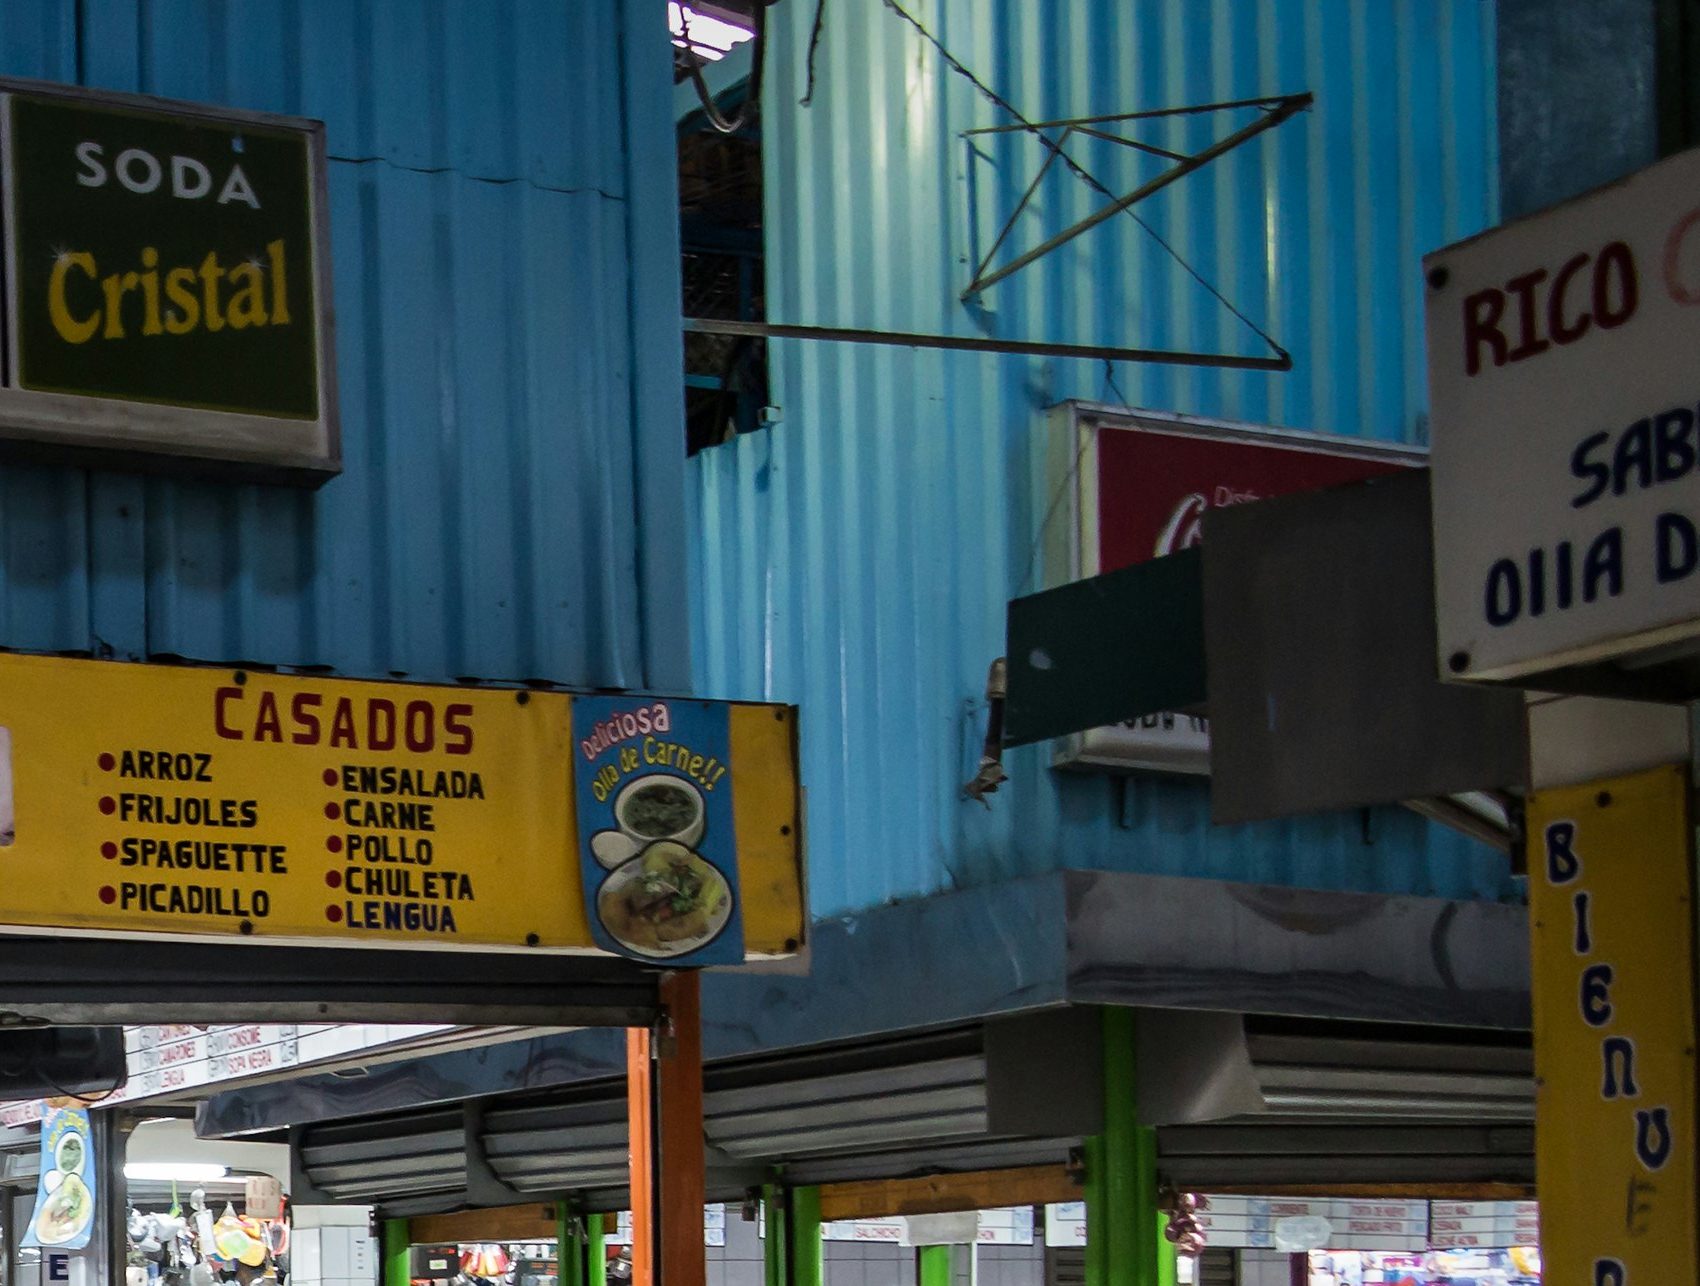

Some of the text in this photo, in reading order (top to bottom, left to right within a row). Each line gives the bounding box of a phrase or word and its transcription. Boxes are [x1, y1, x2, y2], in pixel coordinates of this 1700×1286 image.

[74, 140, 262, 212] SODA
[47, 238, 293, 346] Cristal
[1461, 239, 1640, 378] RICO
[214, 686, 476, 756] CASADOS
[581, 702, 671, 762] Deliciosa
[119, 750, 213, 783] ARROZ
[619, 746, 640, 773] de
[342, 764, 486, 801] ENSALADA
[119, 792, 259, 829] FRIJOLES
[343, 799, 436, 832] CARNE
[119, 837, 288, 874] SPAGUETTE
[345, 833, 434, 866] POLLO
[119, 881, 270, 918] PICADILLO
[344, 867, 476, 902] CHULETA
[345, 900, 458, 934] LENGUA
